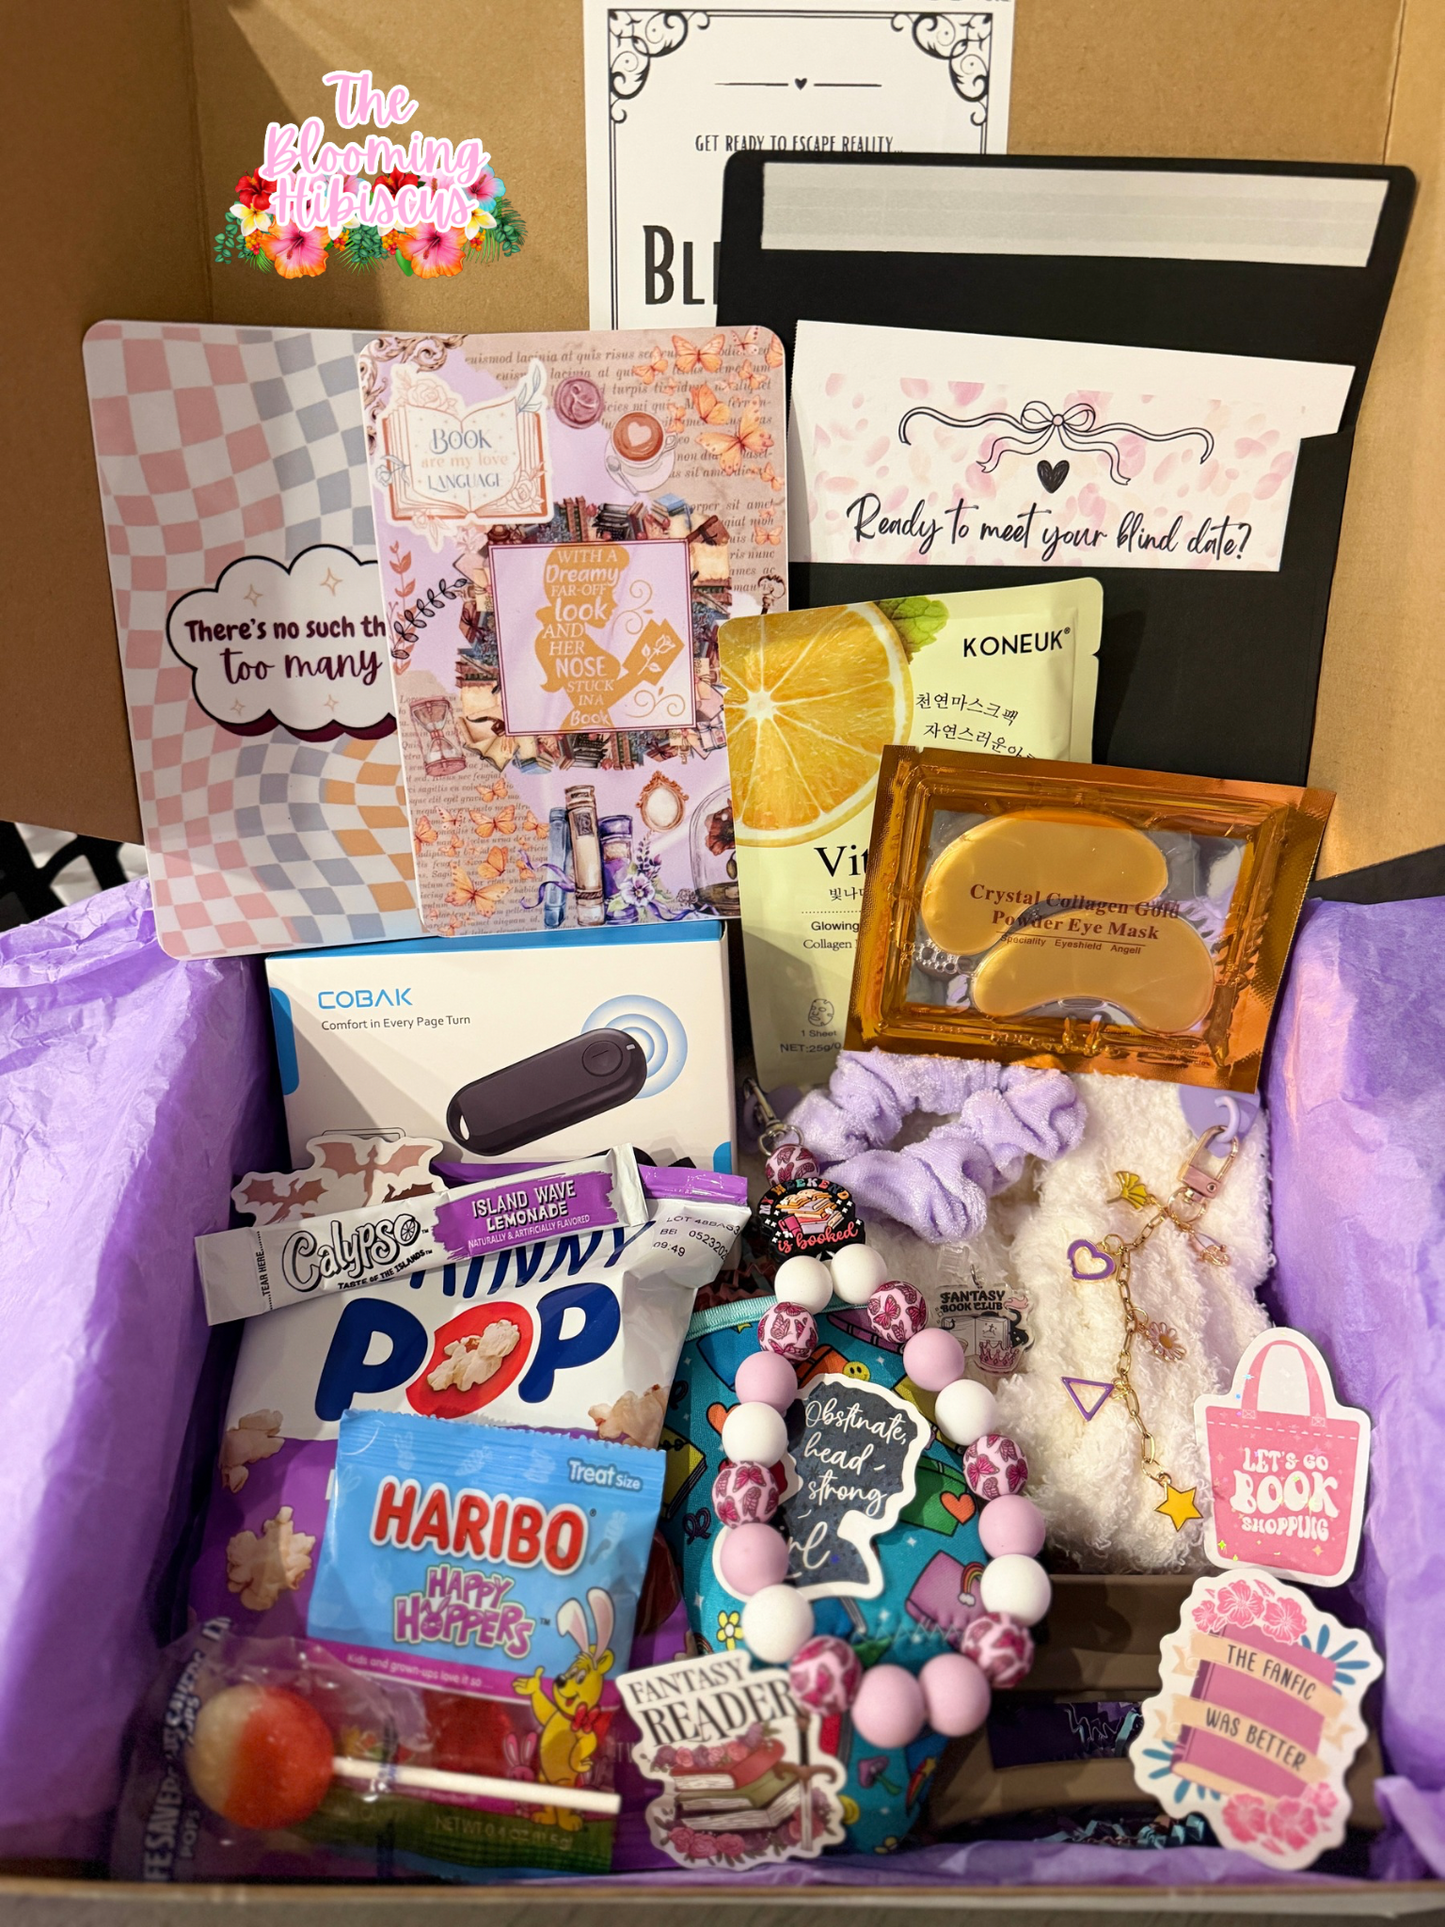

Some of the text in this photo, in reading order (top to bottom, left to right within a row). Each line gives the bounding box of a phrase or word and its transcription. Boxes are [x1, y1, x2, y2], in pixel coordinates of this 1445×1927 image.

[695, 135, 719, 151] GET
[726, 135, 765, 151] READY
[770, 135, 788, 151] TO
[793, 135, 836, 151] ESCAPE
[429, 428, 492, 454] BOOK
[421, 452, 509, 470] are my love
[846, 492, 1252, 561] Ready to meet your blind date?
[557, 549, 618, 563] WITH A
[545, 564, 621, 587] Dreamy
[551, 583, 607, 597] FAR-OFF
[555, 597, 609, 622] look
[184, 618, 267, 643] There's
[273, 621, 300, 639] no
[306, 615, 355, 639] such
[542, 622, 585, 639] AND
[549, 641, 586, 656] HER
[220, 647, 383, 686] too many
[556, 656, 608, 678] NOSE
[567, 679, 615, 693] STUCK
[578, 694, 605, 706] IN A
[915, 692, 1019, 726] 천연마스크팩
[570, 709, 611, 727] Book
[970, 883, 1181, 919] Crystal Collagen Gold
[811, 921, 860, 933] Glowing
[992, 910, 1160, 940] Powder Eye Mask
[803, 938, 852, 951] Collagen
[1054, 938, 1103, 951] Eyeshield
[317, 987, 413, 1010] COBAK
[321, 1015, 471, 1031] Comfort in Every Page Turn
[809, 1029, 837, 1038] Sheet
[472, 1180, 577, 1218] ISLAND WAVE
[759, 1177, 850, 1215] MY WEEKEND
[486, 1200, 568, 1233] LEMONADE
[468, 1214, 591, 1249] NATURALLY & ARTIFICIALLY FLAVORED
[777, 1221, 859, 1254] is booked
[653, 1241, 686, 1257] 09:49
[261, 1272, 269, 1297] TEAR
[338, 1278, 368, 1290] TASTE
[369, 1275, 379, 1284] OF
[380, 1269, 394, 1280] THE
[940, 1290, 1005, 1304] FANTASY
[940, 1301, 1003, 1313] BOOK CLUB
[314, 1282, 621, 1421] POP
[805, 1398, 907, 1446] Obstinate,
[1242, 1447, 1329, 1473] LET'S GO
[568, 1460, 641, 1491] Treat Size
[808, 1469, 887, 1517] strong
[1230, 1469, 1339, 1518] BOOK
[1241, 1515, 1329, 1542] SHOPPING
[427, 1565, 514, 1608] HAPPY
[347, 1653, 368, 1666] Kids
[370, 1655, 389, 1669] and
[390, 1660, 439, 1680] grown-ups
[440, 1669, 460, 1684] love
[462, 1673, 470, 1685] it
[626, 1658, 745, 1705] FANTASY
[1226, 1643, 1317, 1701] THE FANFIC
[640, 1678, 799, 1747] READER
[1205, 1706, 1307, 1772] WAS BETTER
